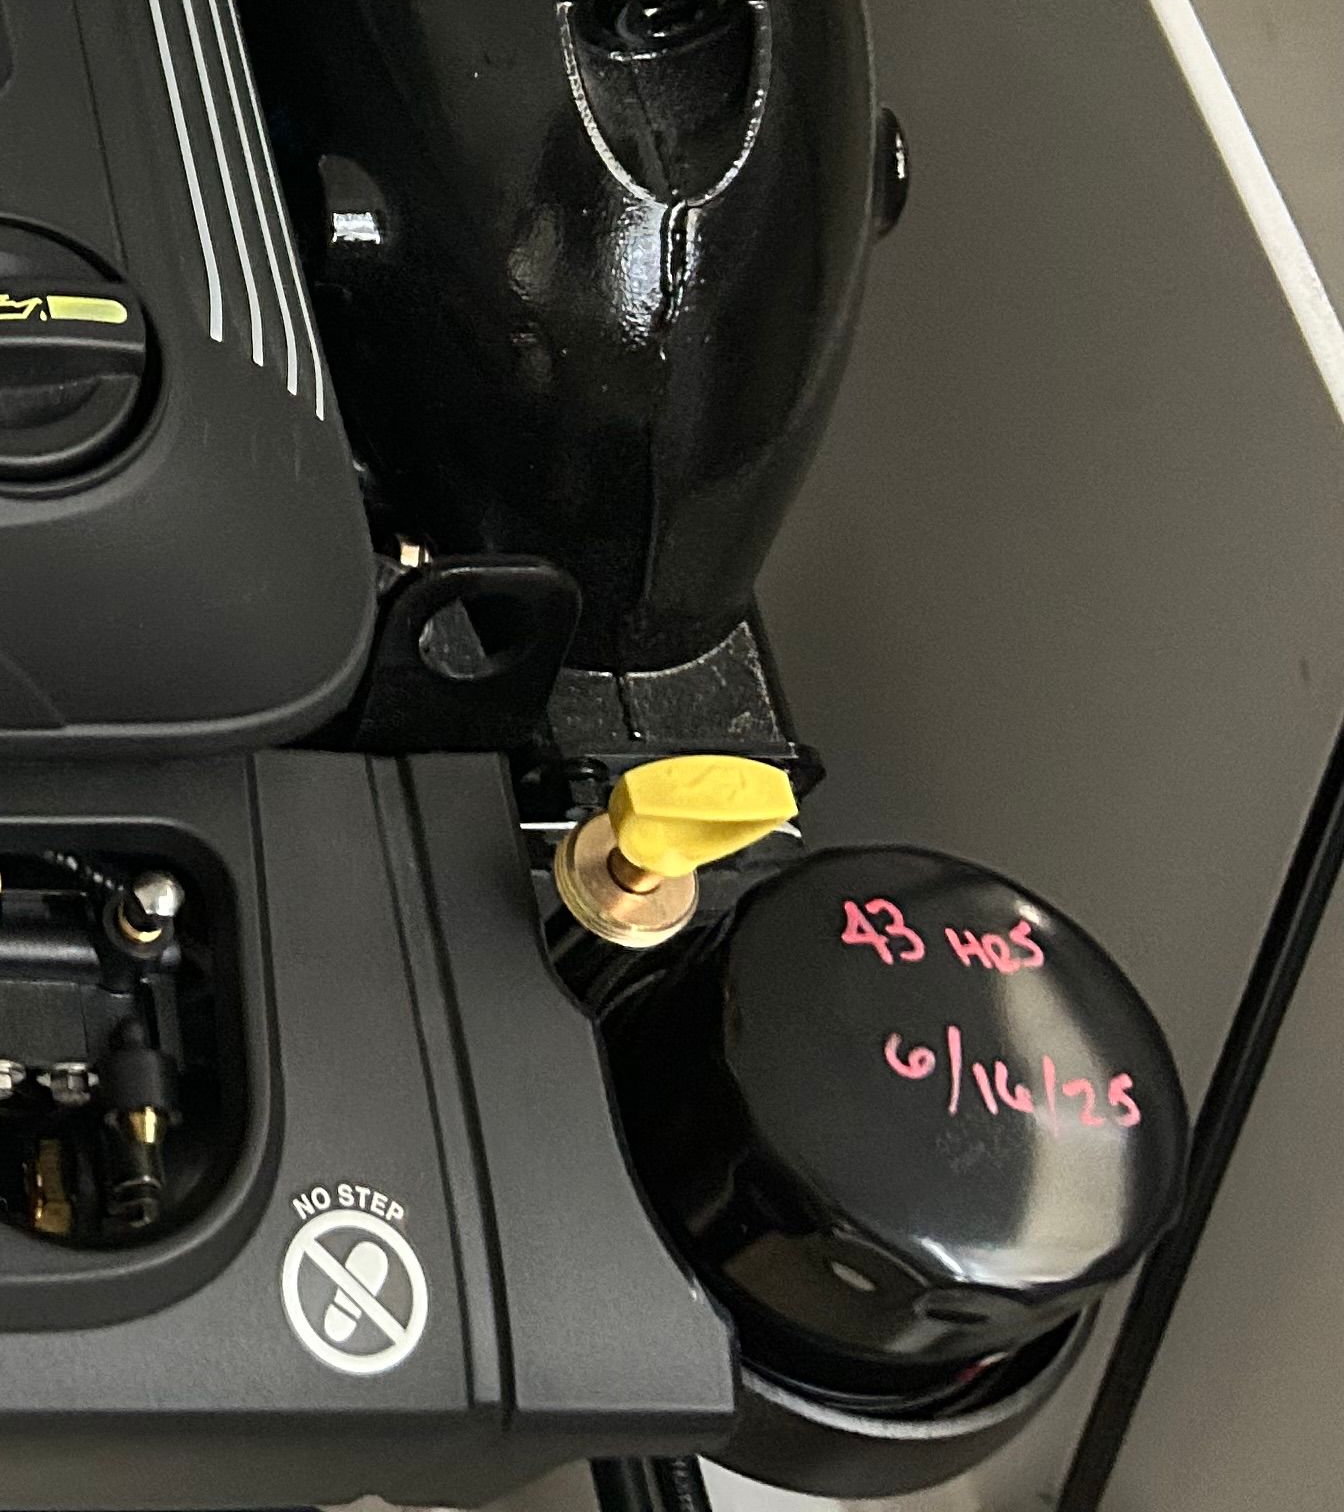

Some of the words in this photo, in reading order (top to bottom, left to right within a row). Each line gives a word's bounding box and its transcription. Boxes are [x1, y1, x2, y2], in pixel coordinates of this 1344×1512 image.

[840, 897, 925, 965] 43
[292, 1187, 331, 1220] NO
[337, 1183, 405, 1221] STEP
